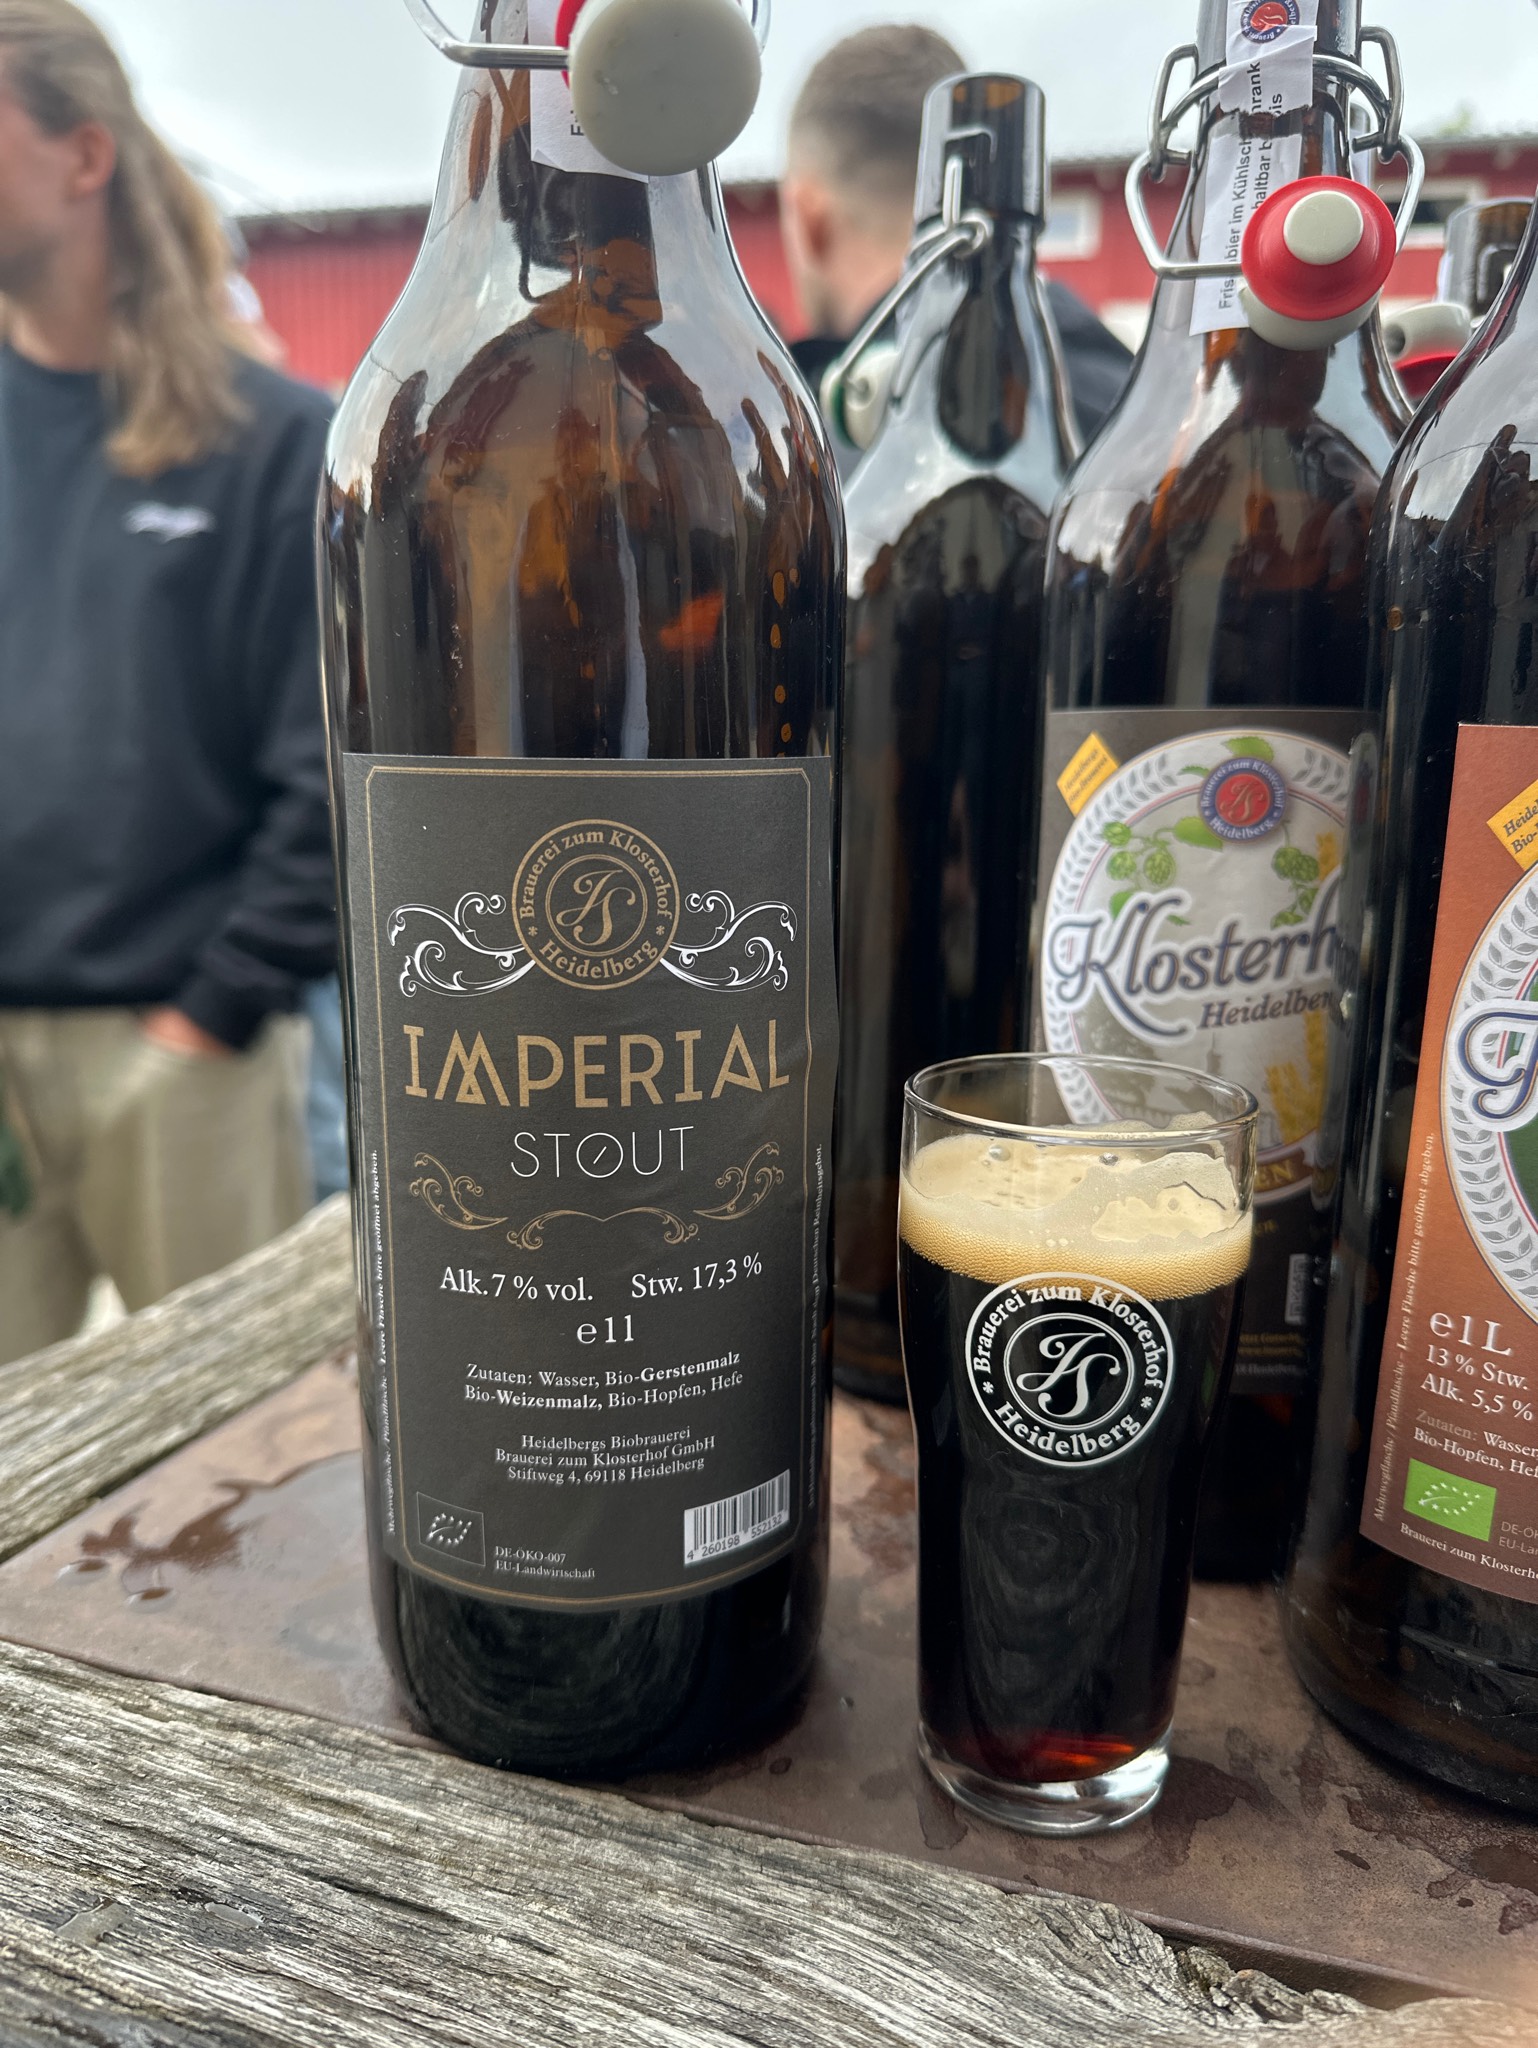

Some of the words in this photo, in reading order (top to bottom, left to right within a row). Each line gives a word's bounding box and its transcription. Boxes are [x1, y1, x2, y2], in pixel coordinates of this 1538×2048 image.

[1251, 155, 1271, 209] haltbar
[1228, 204, 1244, 224] im
[1218, 228, 1241, 309] Frisbier
[1511, 822, 1538, 854] Bio-
[519, 840, 562, 919] Brauerei
[561, 830, 605, 850] zum
[609, 829, 673, 920] Klosterhof
[539, 939, 659, 979] Heidelberg
[1048, 876, 1338, 1036] Klosterh
[1197, 988, 1334, 1029] Heidelber
[403, 1018, 790, 1108] IMPERIAL
[371, 1149, 381, 1201] abgeben.
[1419, 1133, 1435, 1185] abgeben.
[1413, 1187, 1428, 1237] geöffnet
[1408, 1239, 1421, 1267] bitte
[545, 1276, 594, 1301] vol.
[631, 1273, 684, 1299] Stw.
[692, 1258, 738, 1290] 17,3
[1401, 1267, 1418, 1315] Flasche
[973, 1288, 1026, 1374] Brauerei
[1027, 1285, 1082, 1304] zum
[1088, 1285, 1167, 1390] Klosterhof
[1396, 1314, 1411, 1350] Leere
[466, 1362, 532, 1385] Zutaten:
[538, 1371, 600, 1389] Wasser,
[604, 1351, 741, 1386] Bio-Gerstenmalz
[1426, 1345, 1450, 1366] 13
[1481, 1361, 1528, 1390] Stw.
[464, 1384, 603, 1411] Bio-Weizenmalz,
[608, 1383, 707, 1408] Bio-Hopfen,
[710, 1371, 743, 1392] Hefe
[1420, 1372, 1464, 1402] Alk.
[1471, 1389, 1504, 1413] 5,5
[521, 1434, 607, 1452] Heidelbergs
[611, 1425, 691, 1449] Biobrauerei
[994, 1401, 1142, 1457] Heidelberg
[1416, 1408, 1478, 1441] Zutaten:
[495, 1447, 553, 1466] Brauerei
[557, 1456, 588, 1467] zum
[593, 1445, 669, 1467] Klosterhof
[672, 1435, 715, 1457] GmbH
[1413, 1427, 1504, 1470] Bio-Hopfen,
[508, 1465, 564, 1485] Stiftweg
[568, 1470, 581, 1485] 4,
[585, 1468, 626, 1482] 69118
[631, 1457, 705, 1480] Heidelberg
[495, 1545, 567, 1563] DE-ÖKO-007
[701, 1535, 741, 1557] 260198
[1400, 1522, 1447, 1552] Brauerei
[1449, 1546, 1476, 1562] zum
[495, 1559, 595, 1578] EU-Landwirtschaft
